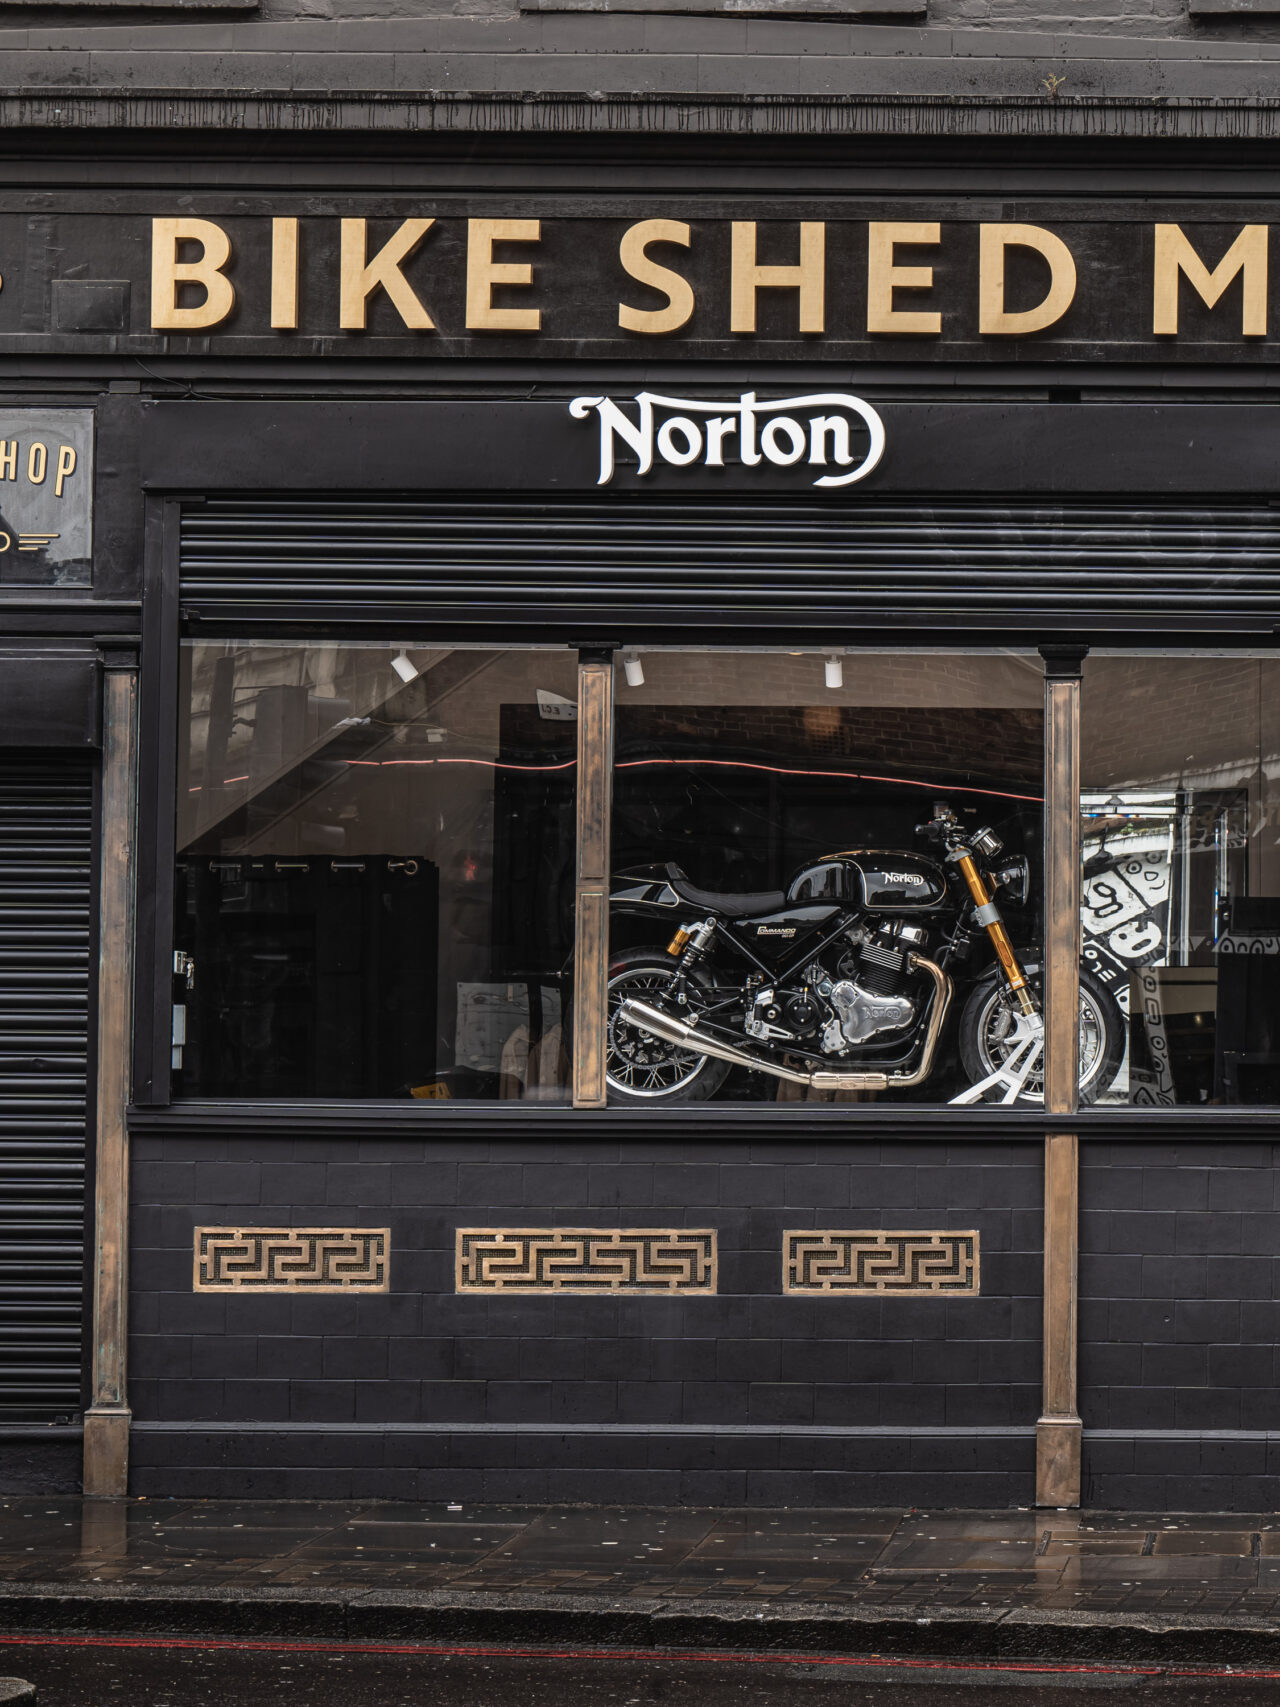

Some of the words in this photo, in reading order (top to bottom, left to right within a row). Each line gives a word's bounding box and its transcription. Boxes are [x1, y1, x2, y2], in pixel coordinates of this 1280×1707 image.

[151, 216, 542, 330] BIKE
[618, 218, 1077, 334] SHED
[568, 390, 886, 488] Norton
[881, 871, 924, 886] Norton
